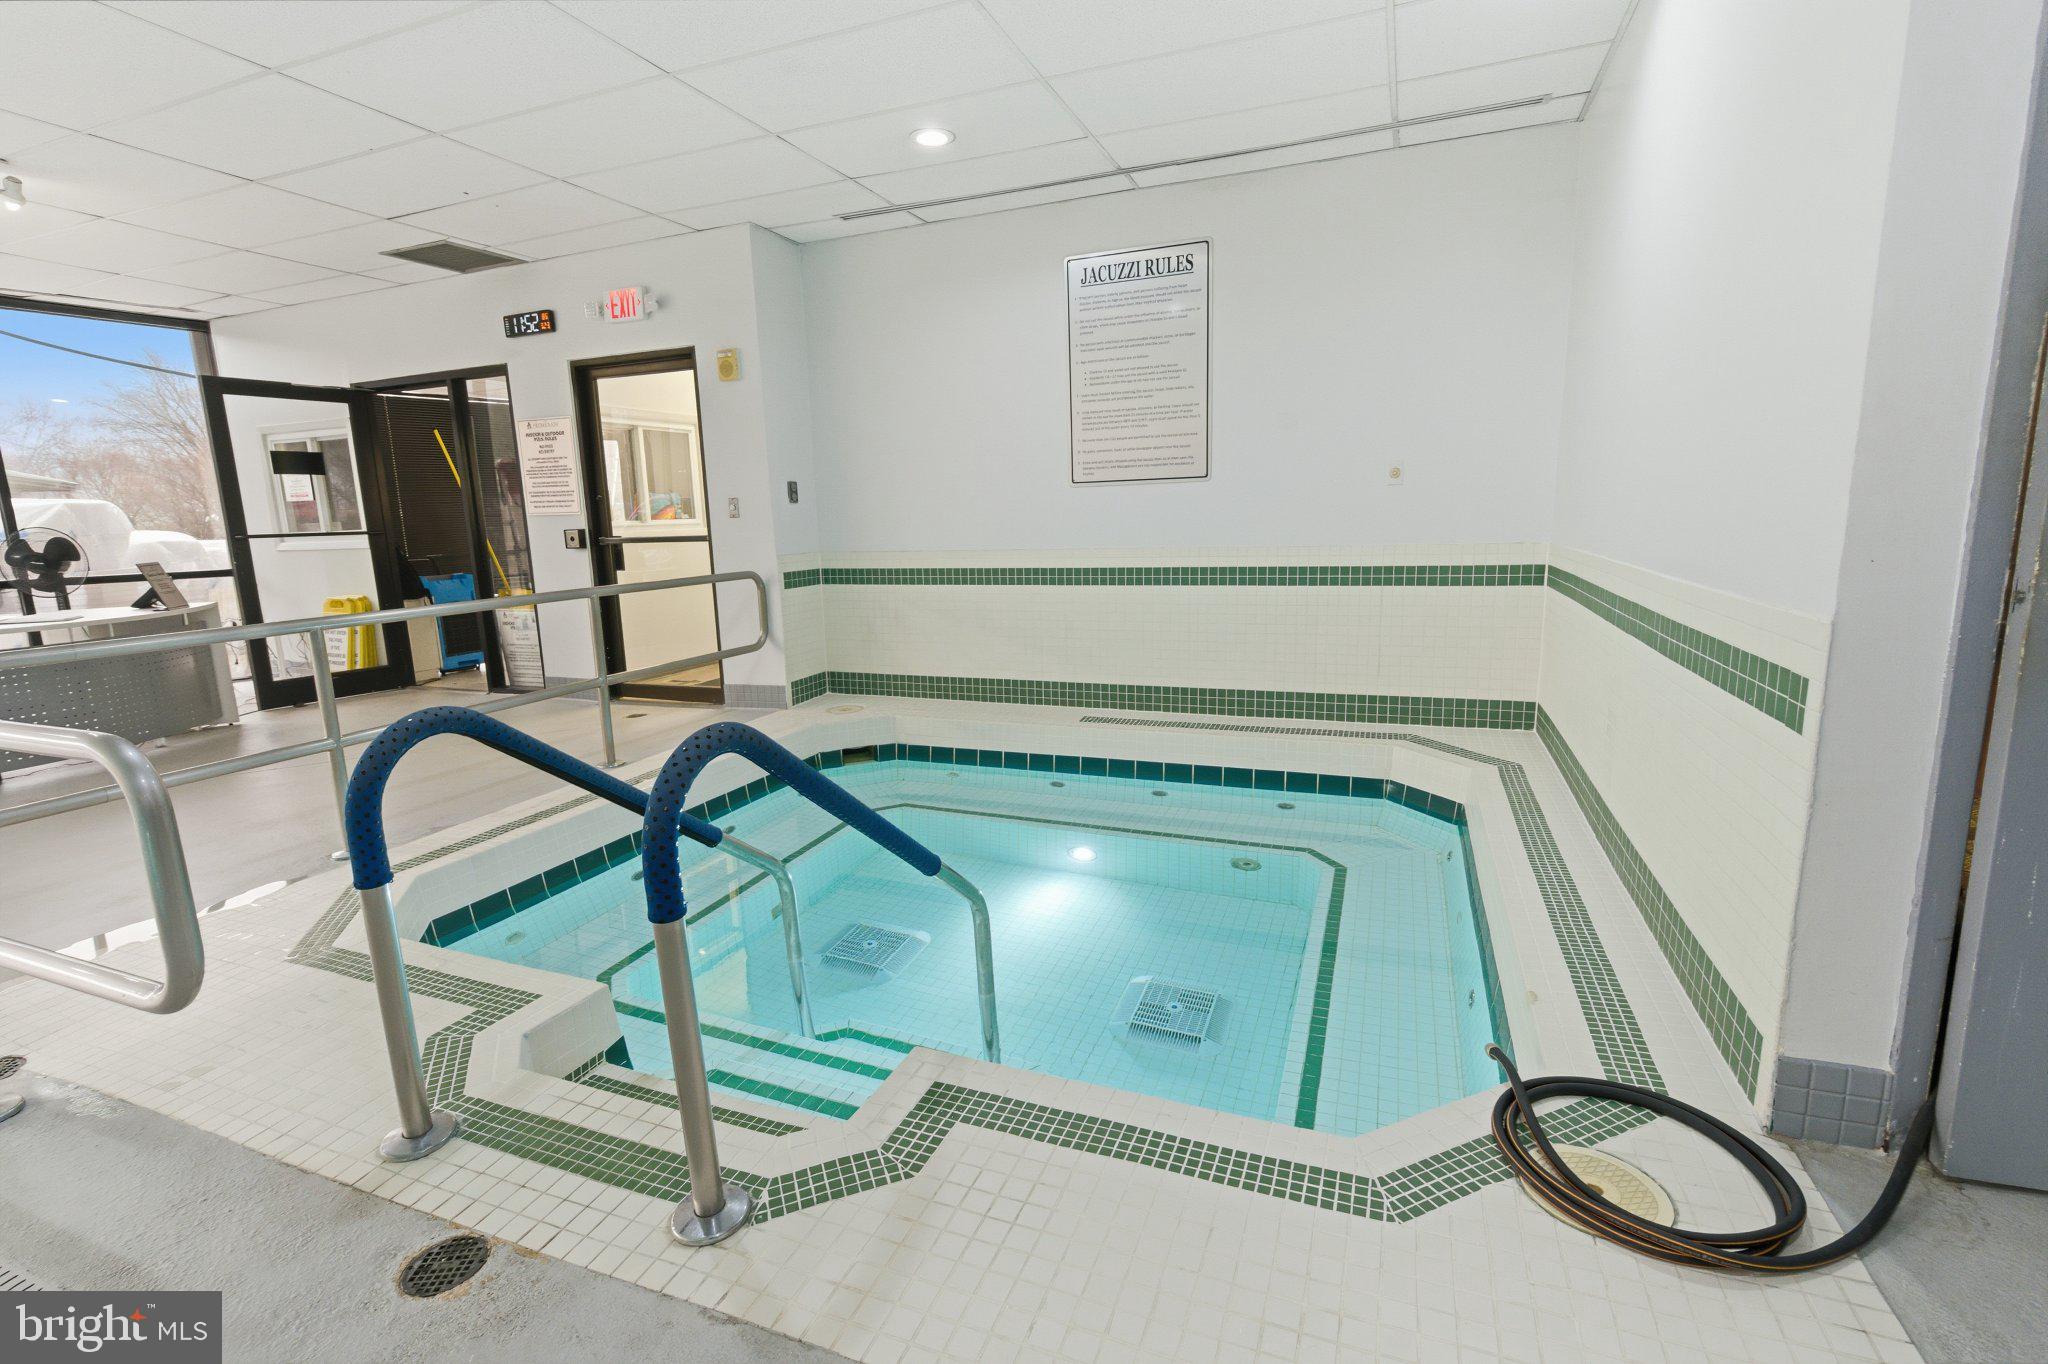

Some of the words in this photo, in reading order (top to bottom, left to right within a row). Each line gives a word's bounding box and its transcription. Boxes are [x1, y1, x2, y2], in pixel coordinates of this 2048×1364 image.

[1080, 260, 1141, 285] JACUZZI
[1145, 253, 1194, 277] RULES
[609, 287, 637, 319] EXIT
